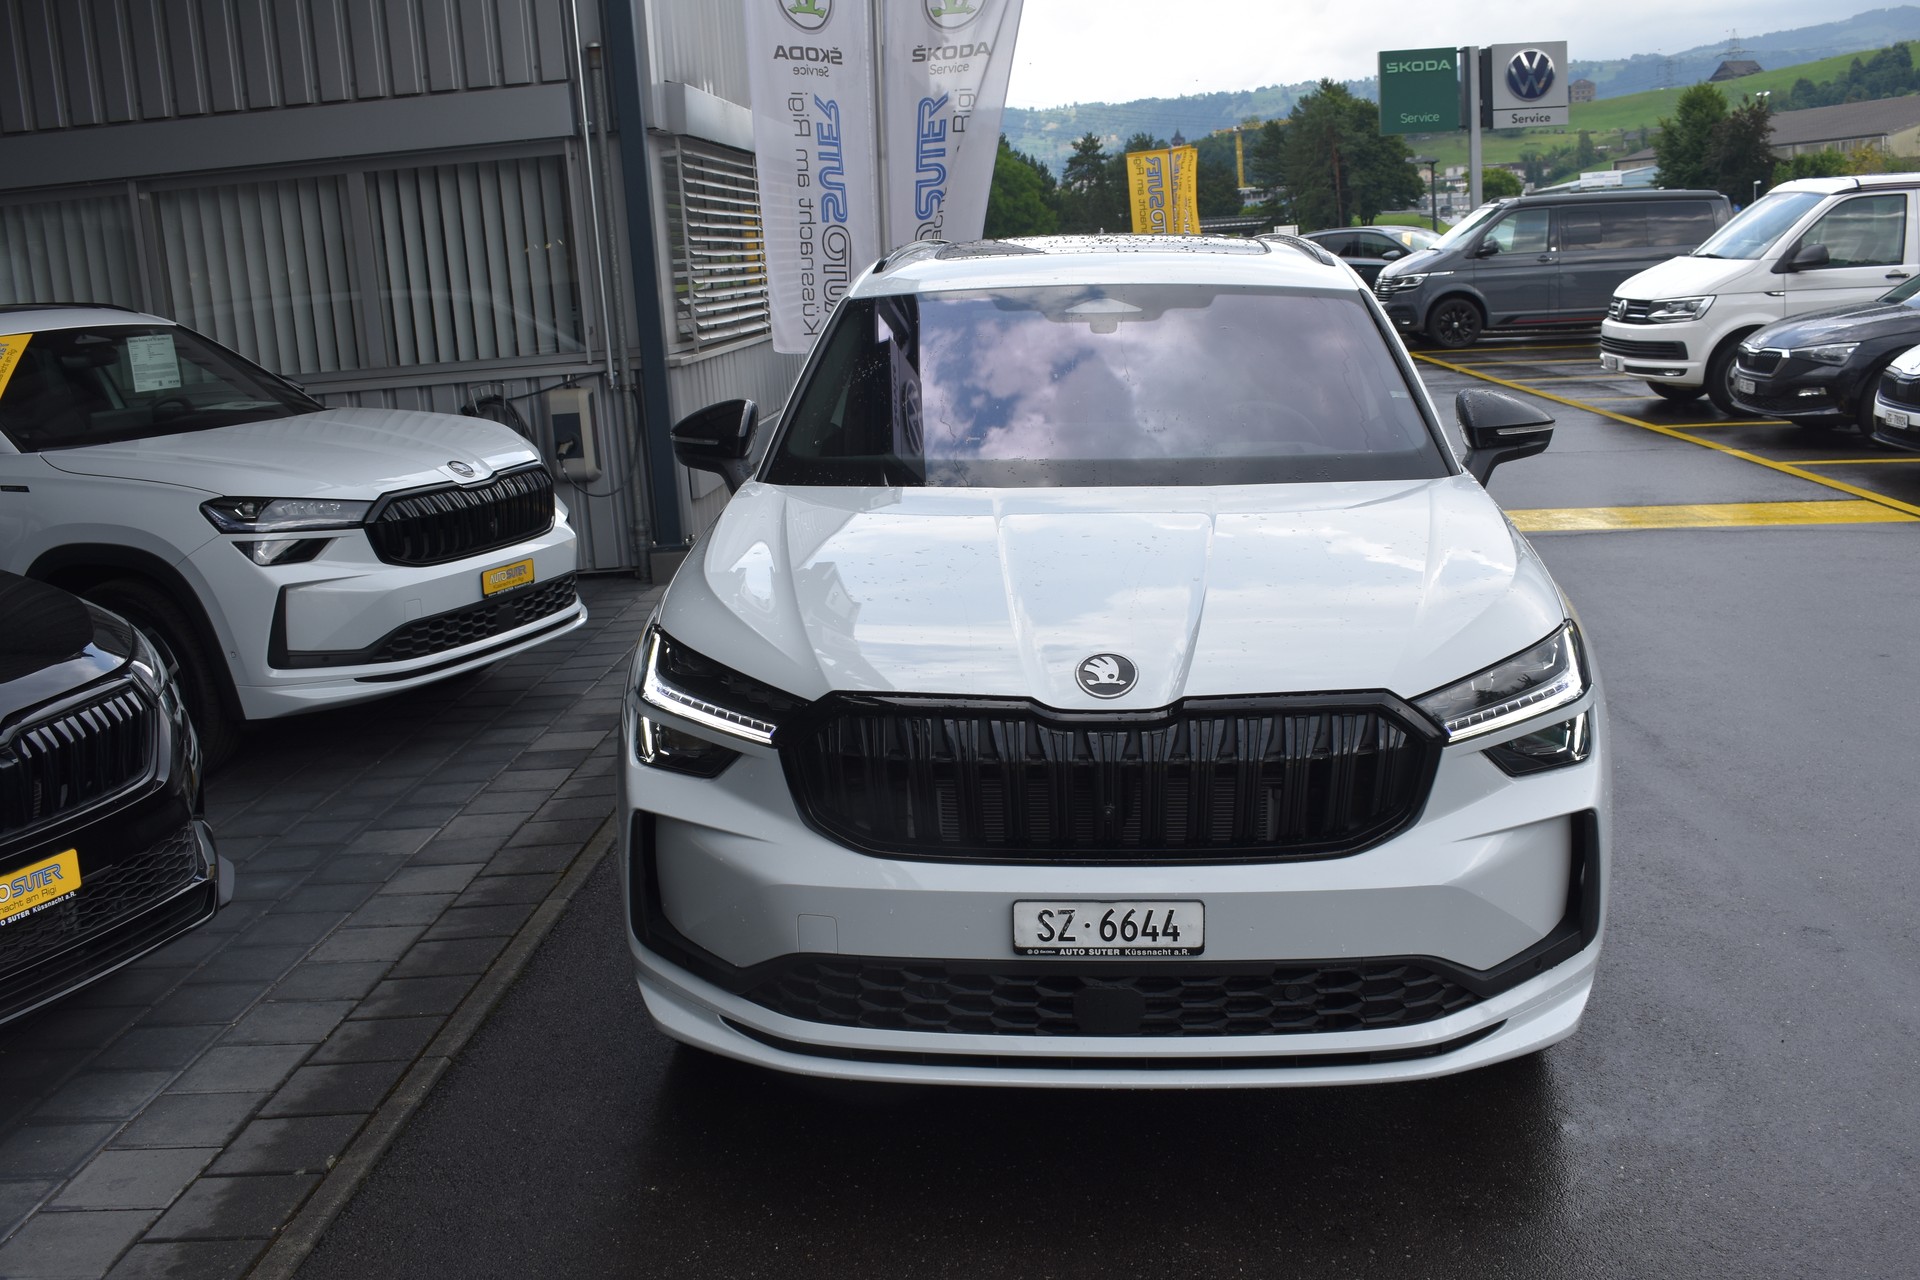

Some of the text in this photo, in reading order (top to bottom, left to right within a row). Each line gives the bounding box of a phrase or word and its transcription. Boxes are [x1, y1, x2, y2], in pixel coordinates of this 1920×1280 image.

[912, 42, 992, 62] ŠKODA
[929, 62, 970, 76] Service
[1400, 112, 1440, 124] Service
[1511, 113, 1551, 124] Service
[7, 910, 30, 924] SUTER
[1060, 948, 1085, 956] AUTO
[1088, 948, 1120, 956] SUTER
[1125, 948, 1171, 956] Küssnacht
[1174, 948, 1190, 956] a.R.
